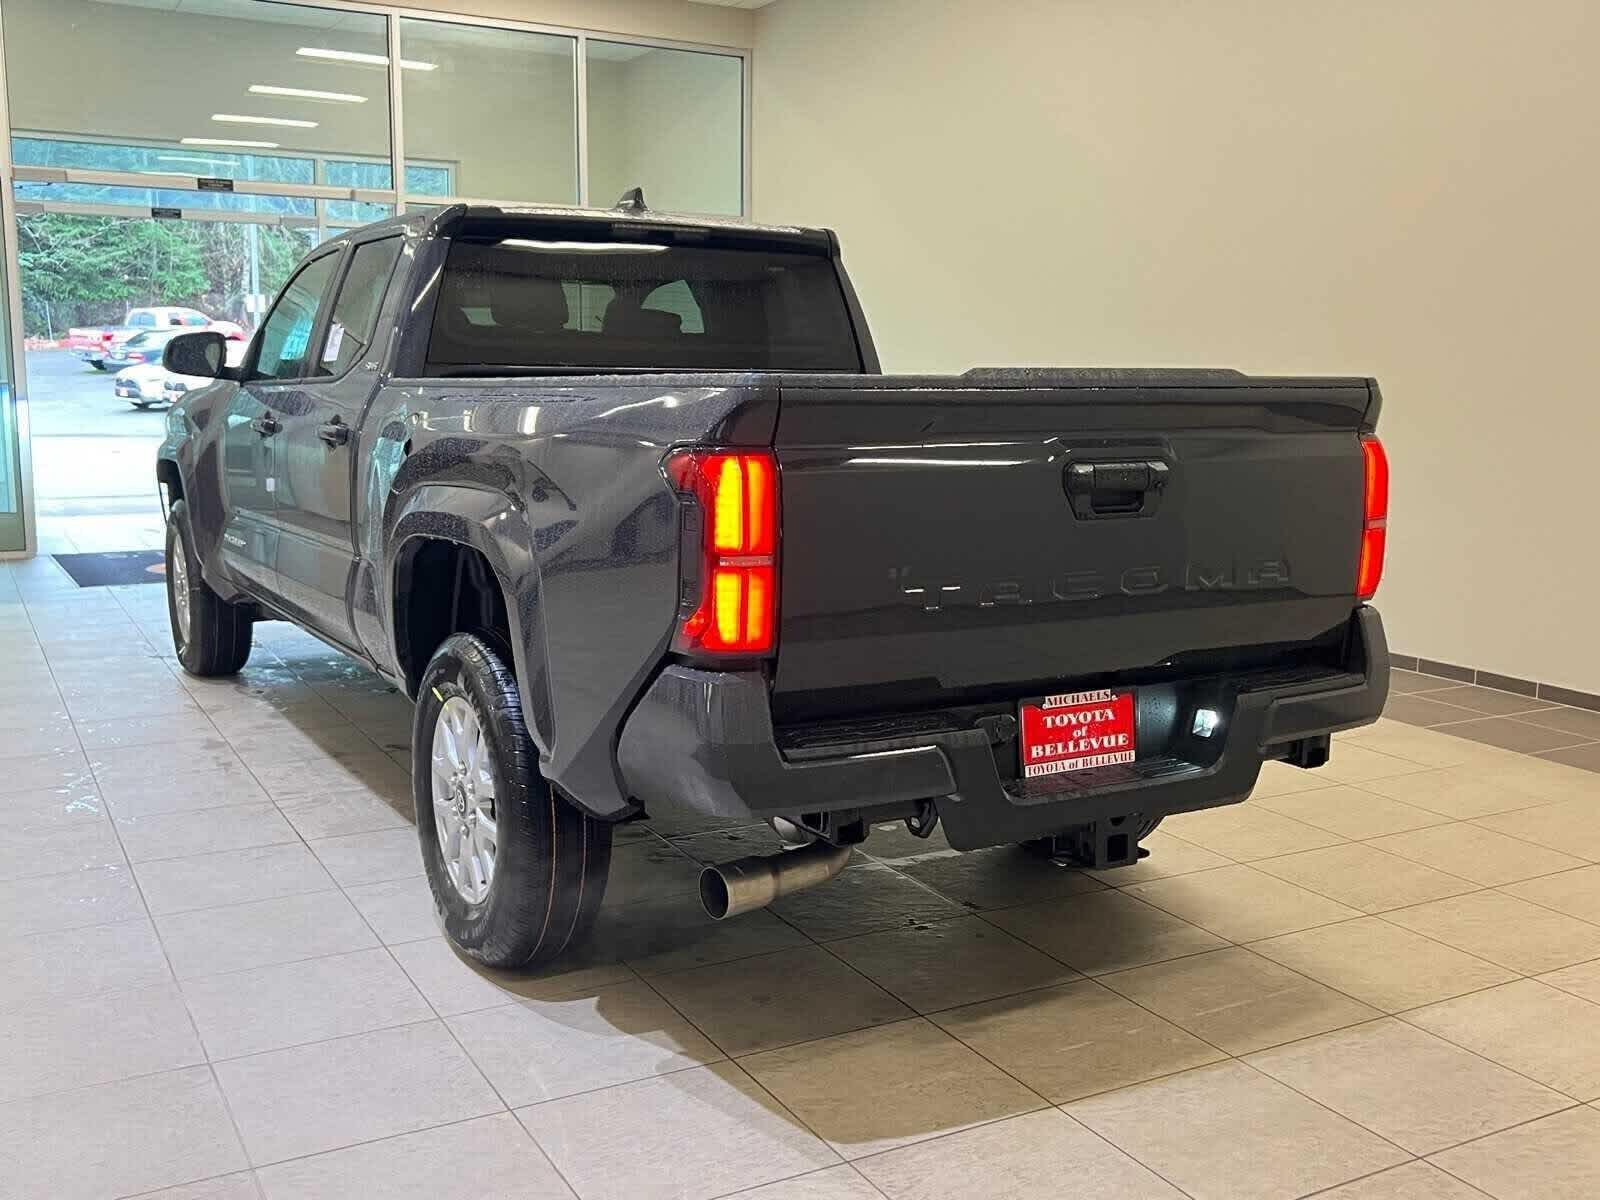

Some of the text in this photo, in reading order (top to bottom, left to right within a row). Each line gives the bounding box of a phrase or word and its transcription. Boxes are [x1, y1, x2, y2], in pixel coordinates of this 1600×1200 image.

[894, 559, 1291, 610] TACOMA
[1046, 690, 1110, 706] MICHAELS
[1043, 708, 1115, 728] TOYOTA
[1072, 726, 1088, 738] of
[1031, 733, 1129, 758] BELLEVUE
[1027, 751, 1134, 776] TOYOTA of BELLEVUE
